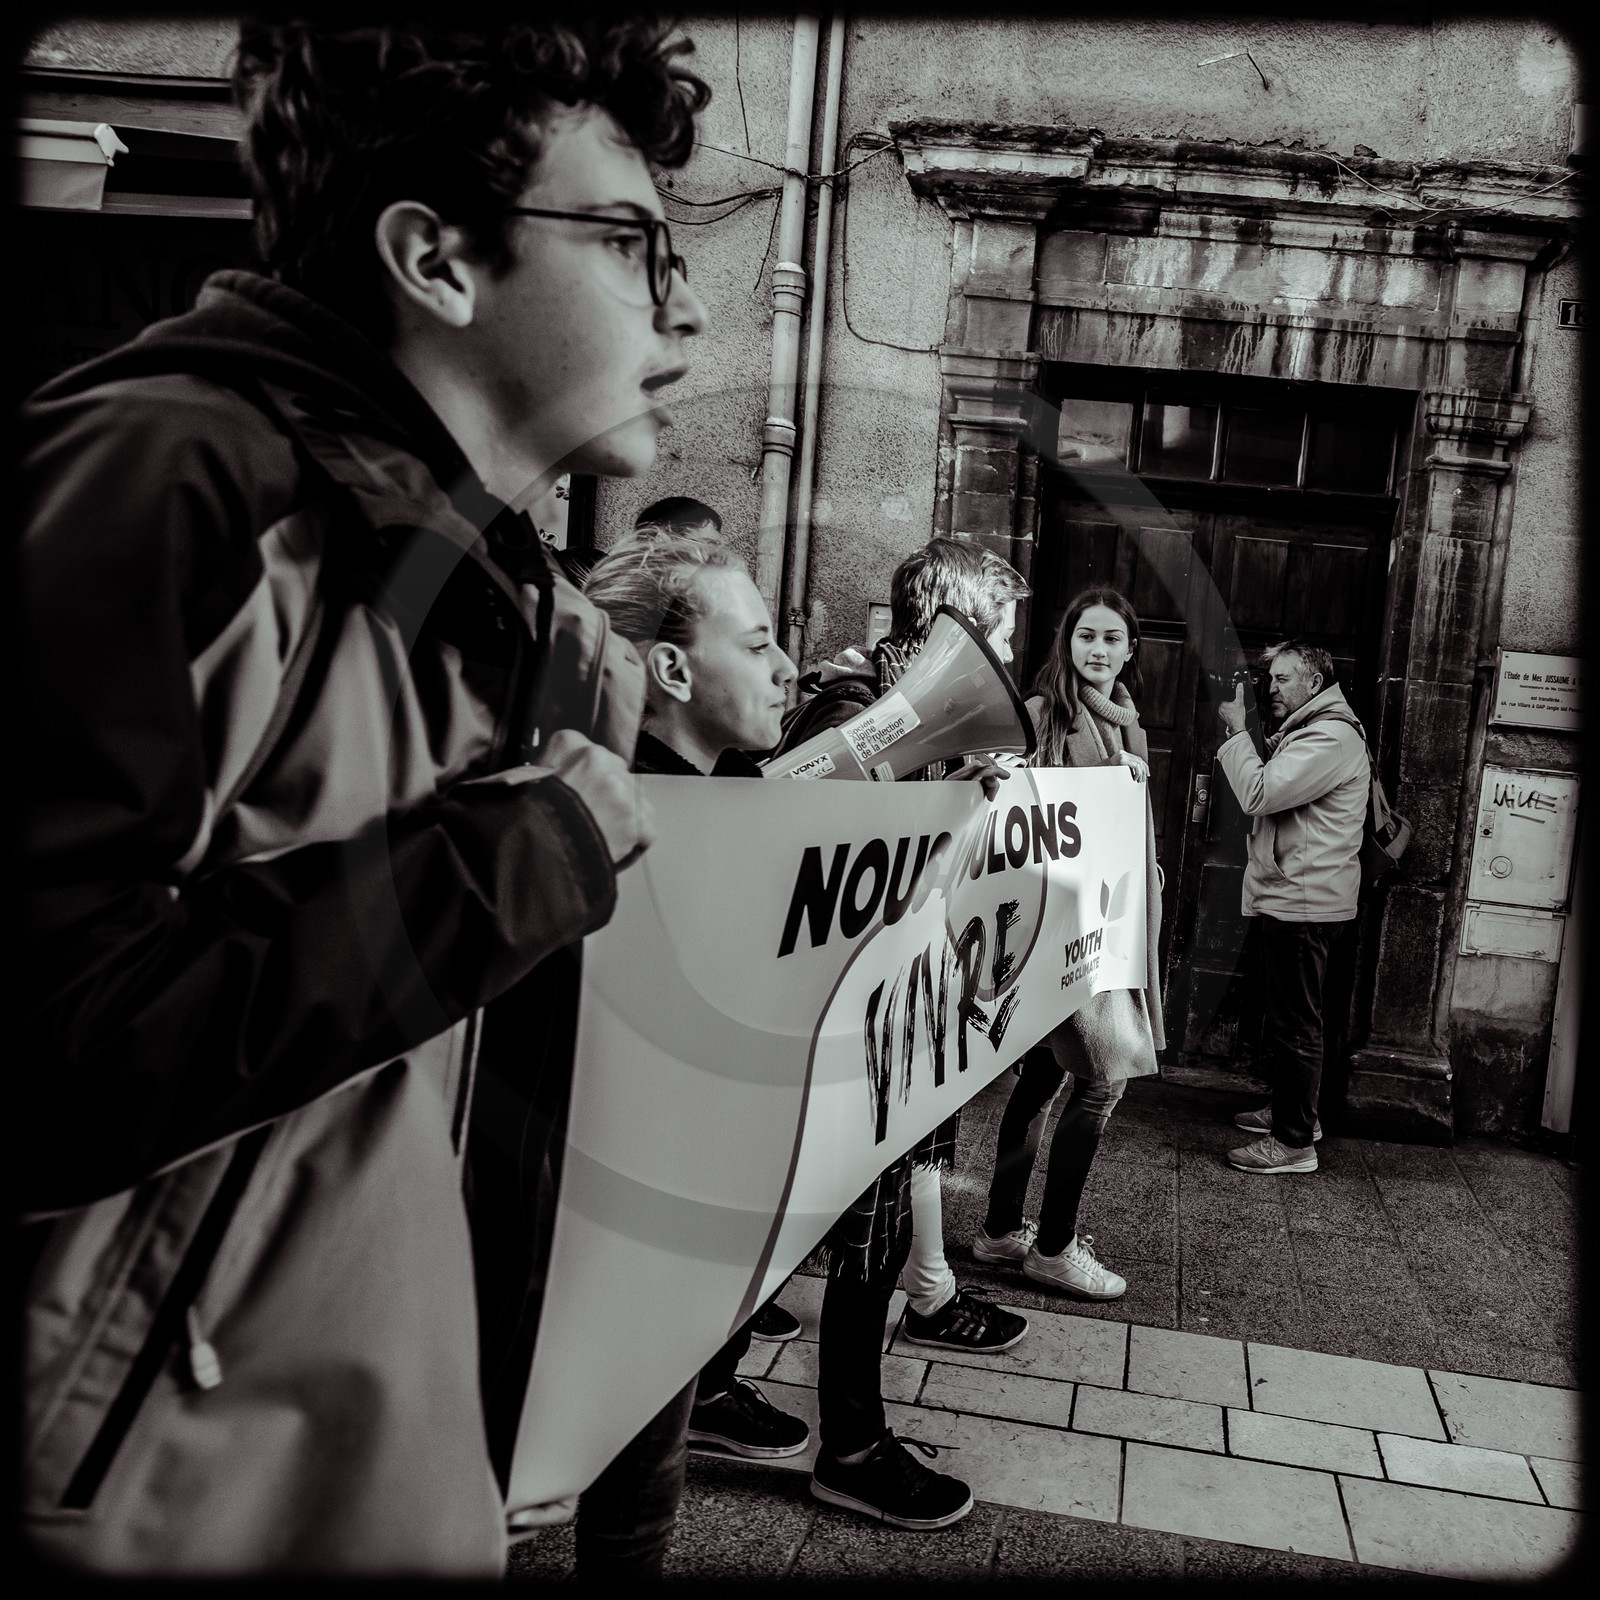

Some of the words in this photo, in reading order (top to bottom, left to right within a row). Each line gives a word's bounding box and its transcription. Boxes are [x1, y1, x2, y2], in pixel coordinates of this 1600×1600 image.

[1523, 672, 1530, 681] de
[847, 718, 875, 738] Société
[852, 725, 876, 744] Alpine
[856, 741, 867, 751] de
[867, 717, 905, 743] Protection
[861, 749, 872, 759] de
[871, 743, 880, 752] la
[880, 727, 905, 746] Nature
[792, 754, 828, 775] VONYX
[1065, 927, 1103, 968] YOUTH
[1061, 971, 1074, 990] FOR
[1075, 956, 1100, 981] CLIMATE
[864, 898, 1021, 1145] VIVRE
